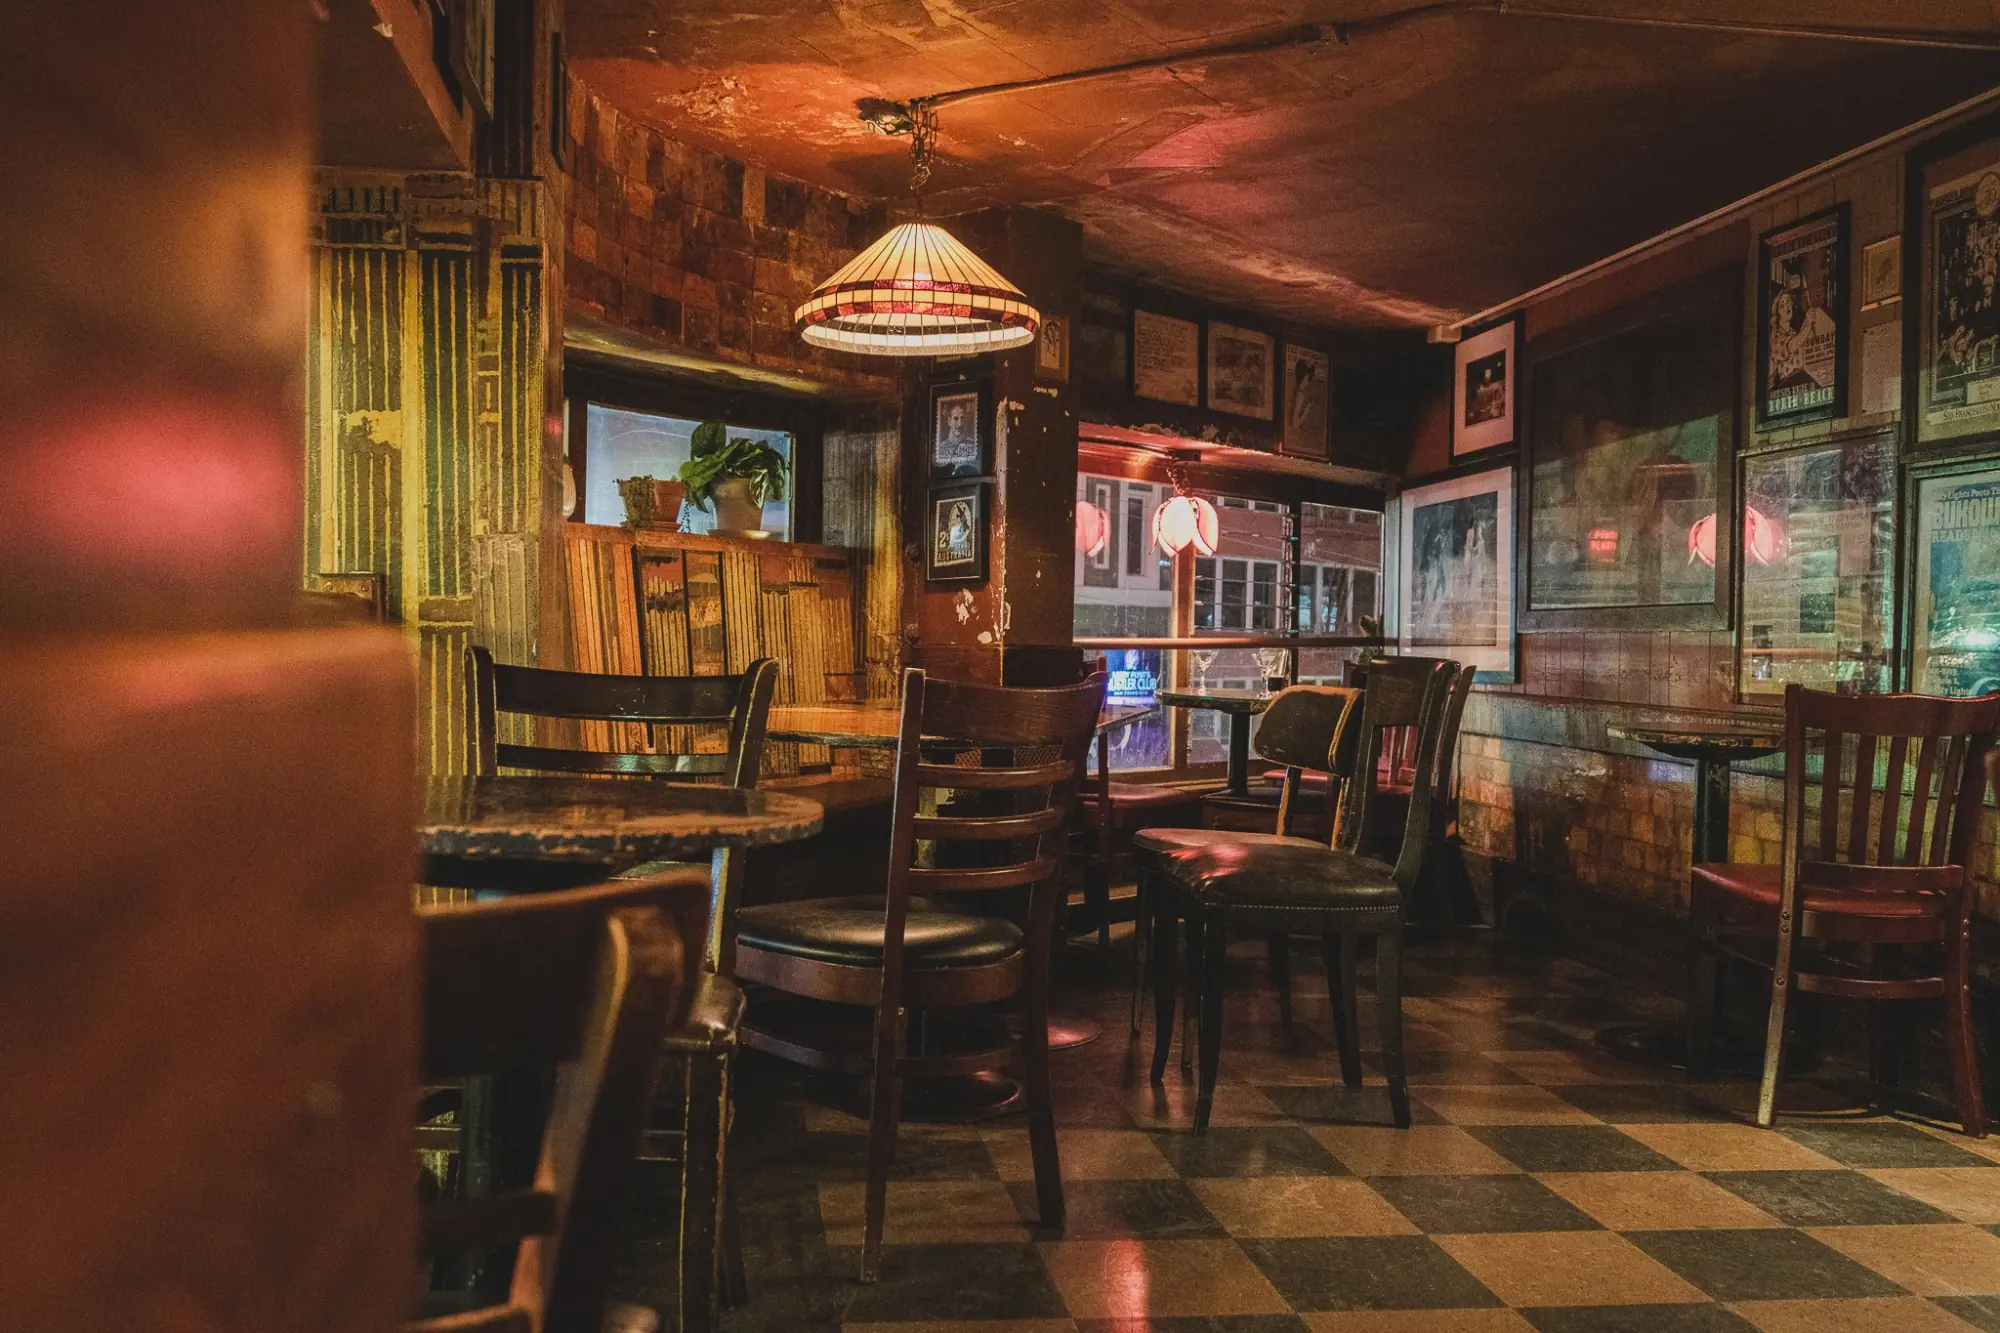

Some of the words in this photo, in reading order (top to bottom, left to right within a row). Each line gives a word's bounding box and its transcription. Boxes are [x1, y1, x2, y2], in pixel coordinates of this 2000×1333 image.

[1806, 331, 1834, 347] SUNDAY
[1803, 386, 1835, 406] BEACH
[1948, 489, 1970, 501] Lights
[1137, 678, 1157, 690] CLUB
